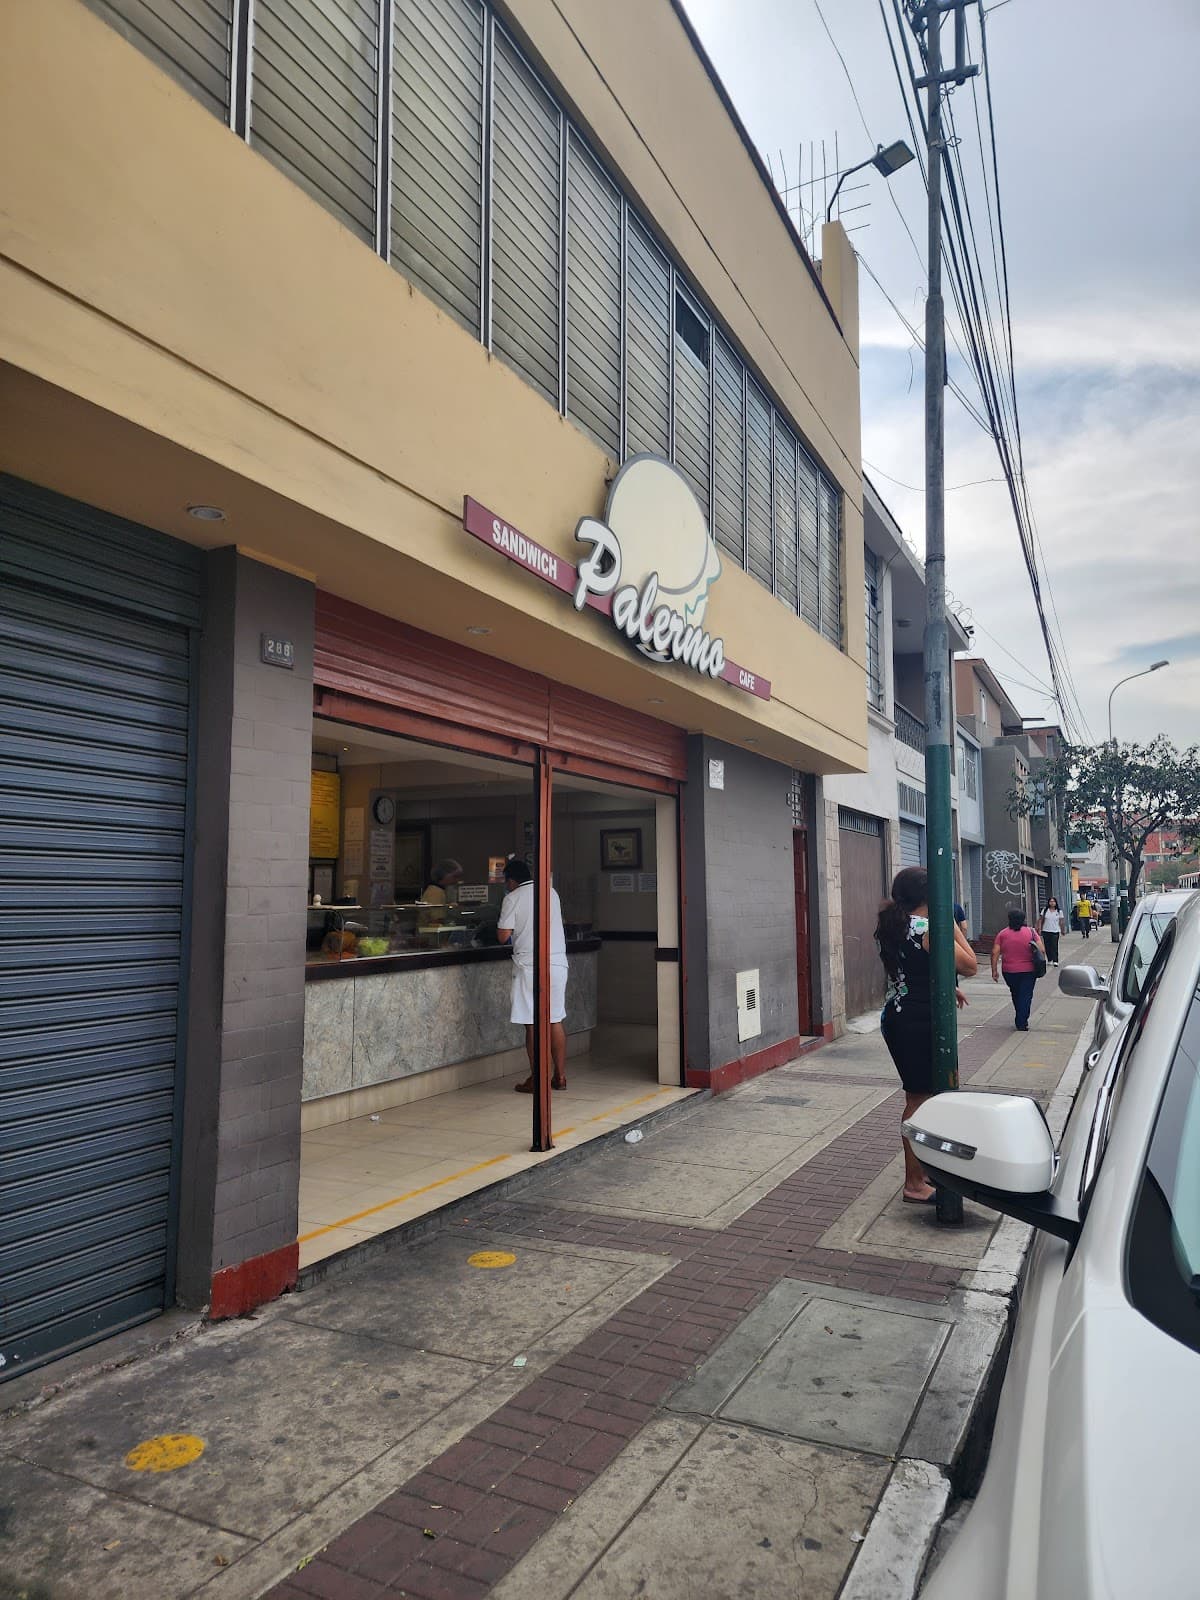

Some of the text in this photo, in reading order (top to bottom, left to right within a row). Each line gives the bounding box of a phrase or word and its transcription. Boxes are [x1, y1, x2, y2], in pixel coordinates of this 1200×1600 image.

[492, 519, 557, 580] SANDWICH
[574, 516, 726, 679] Palermo
[739, 669, 755, 690] CAFE
